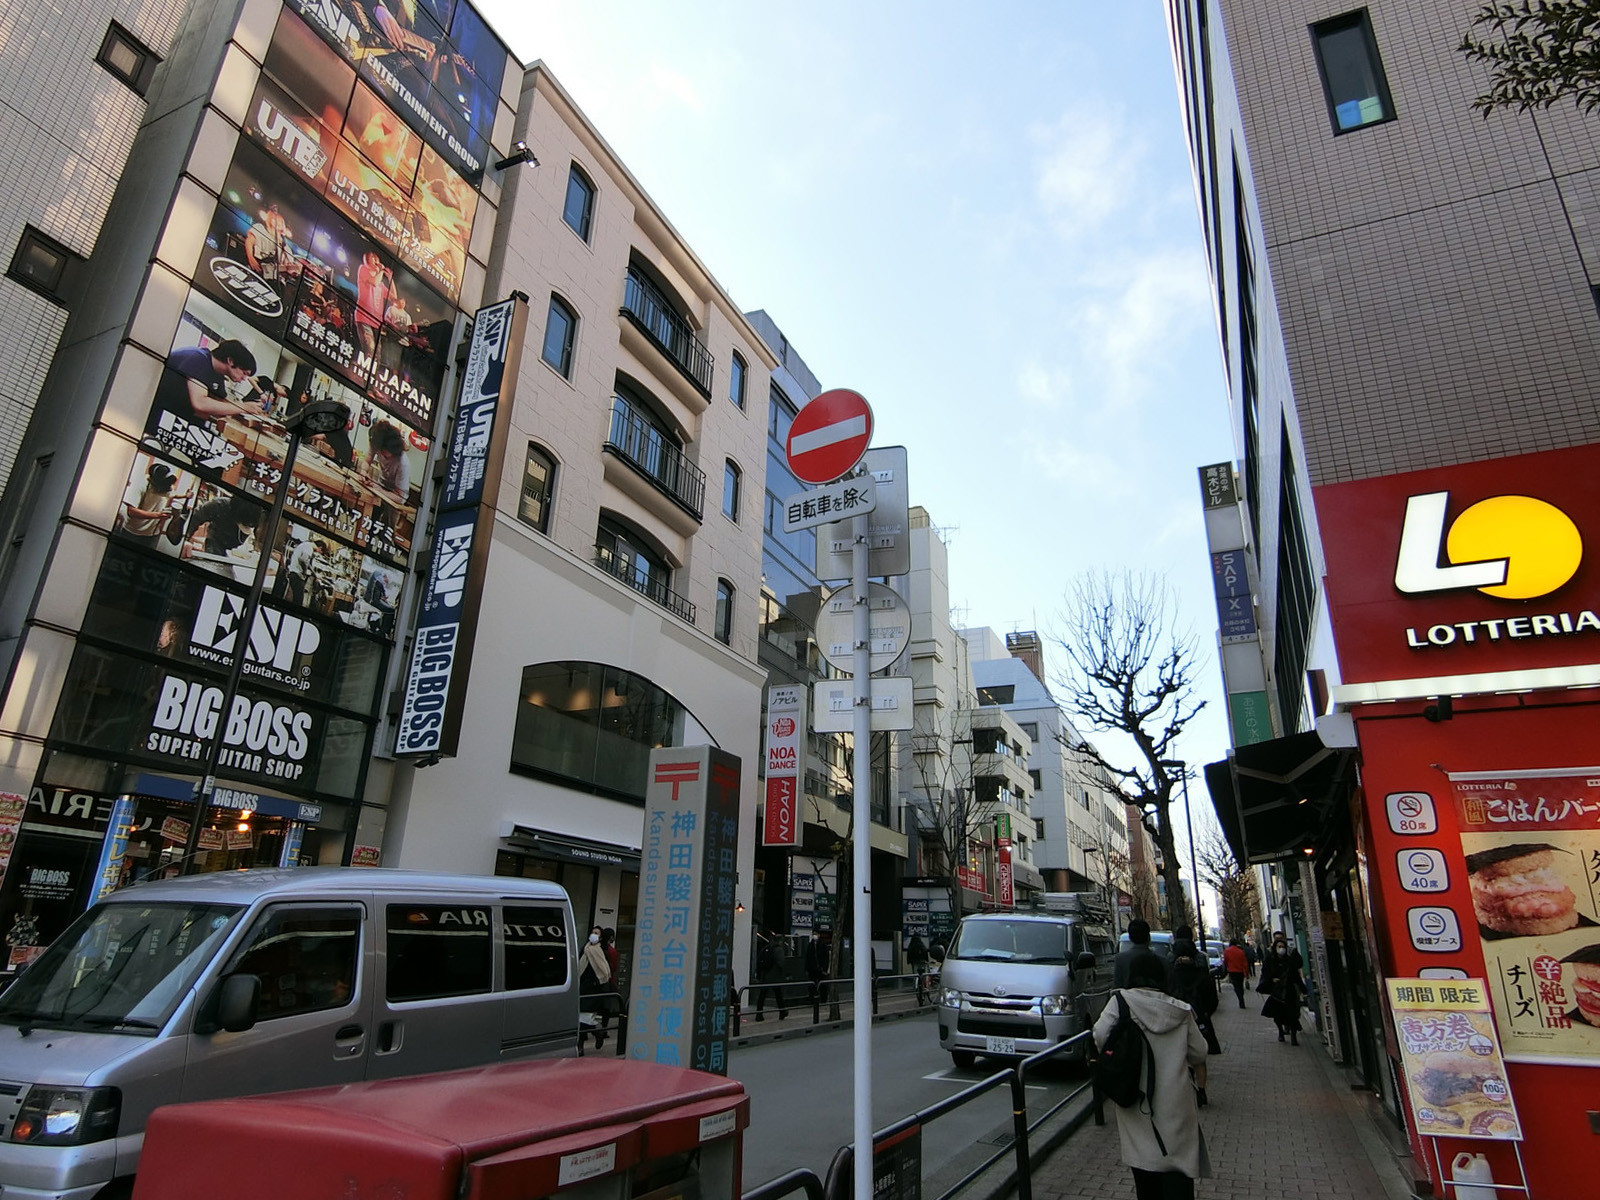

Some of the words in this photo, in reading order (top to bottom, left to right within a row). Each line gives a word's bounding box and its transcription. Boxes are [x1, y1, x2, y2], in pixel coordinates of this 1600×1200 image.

[296, 0, 361, 43] SP
[365, 52, 449, 141] ENTERTAINMENT
[447, 131, 480, 172] GROUP
[331, 184, 360, 212] UNITED
[361, 209, 404, 249] TELEVISION
[404, 246, 455, 291] BROADCASTING
[484, 306, 505, 347] ESP
[292, 327, 351, 368] MUSICIANS
[353, 363, 401, 404] INSTITUTE
[403, 397, 430, 421] JAPAN
[296, 310, 354, 360] 音楽学校
[379, 367, 433, 411] JAPAN
[155, 434, 201, 459] ACADEMY
[157, 428, 188, 447] GUITAR
[464, 401, 496, 458] UTB
[788, 487, 869, 524] 自転車を除く
[1206, 467, 1222, 506] 高木ビル
[251, 480, 274, 496] ESP
[284, 495, 355, 535] UITARCRAFT
[356, 531, 404, 558] ACADEMY
[434, 523, 474, 608] ESP
[1222, 553, 1241, 610] SAPIX
[191, 584, 321, 673] ESP
[413, 630, 426, 668] SUPER
[1405, 610, 1600, 647] LOTTERIA
[419, 626, 457, 674] BIG
[406, 670, 419, 714] GUITAR
[406, 674, 449, 750] BOSS
[772, 696, 798, 706] ノアビル
[153, 675, 225, 740] BIG
[223, 694, 313, 760] BOSS
[399, 717, 410, 751] SHOP
[147, 731, 202, 761] SUPER
[205, 745, 262, 773] UITAR
[265, 758, 304, 781] SHOP
[769, 747, 797, 760] NOA
[769, 760, 796, 771] DANCE
[212, 788, 233, 809] BIG
[231, 791, 259, 812] BOSS
[1456, 783, 1502, 791] LOTTERIA
[300, 805, 320, 818] ESP
[779, 779, 790, 842] NOAH
[1400, 820, 1427, 832] 80席
[1486, 796, 1600, 823] ごはんバー
[571, 848, 589, 858] SOUND
[590, 851, 607, 861] STUDIO
[30, 868, 47, 882] BIG
[47, 869, 71, 884] BOSS
[638, 809, 667, 977] Kandasurugadai
[1410, 877, 1439, 889] 40席
[655, 809, 697, 1069] 神田駿河台郵便局
[708, 816, 736, 1072] 神田駿河台郵便局
[1416, 936, 1458, 945] 喫煙ブース
[633, 983, 654, 1034] Post
[698, 986, 710, 1035] Post
[1396, 986, 1435, 1004] 期間
[1440, 986, 1481, 1005] 限定
[1506, 964, 1535, 1019] チーズ
[1538, 980, 1573, 1030] 絶品
[992, 1043, 1014, 1053] 25-25
[1400, 1013, 1476, 1042] 恵方巻
